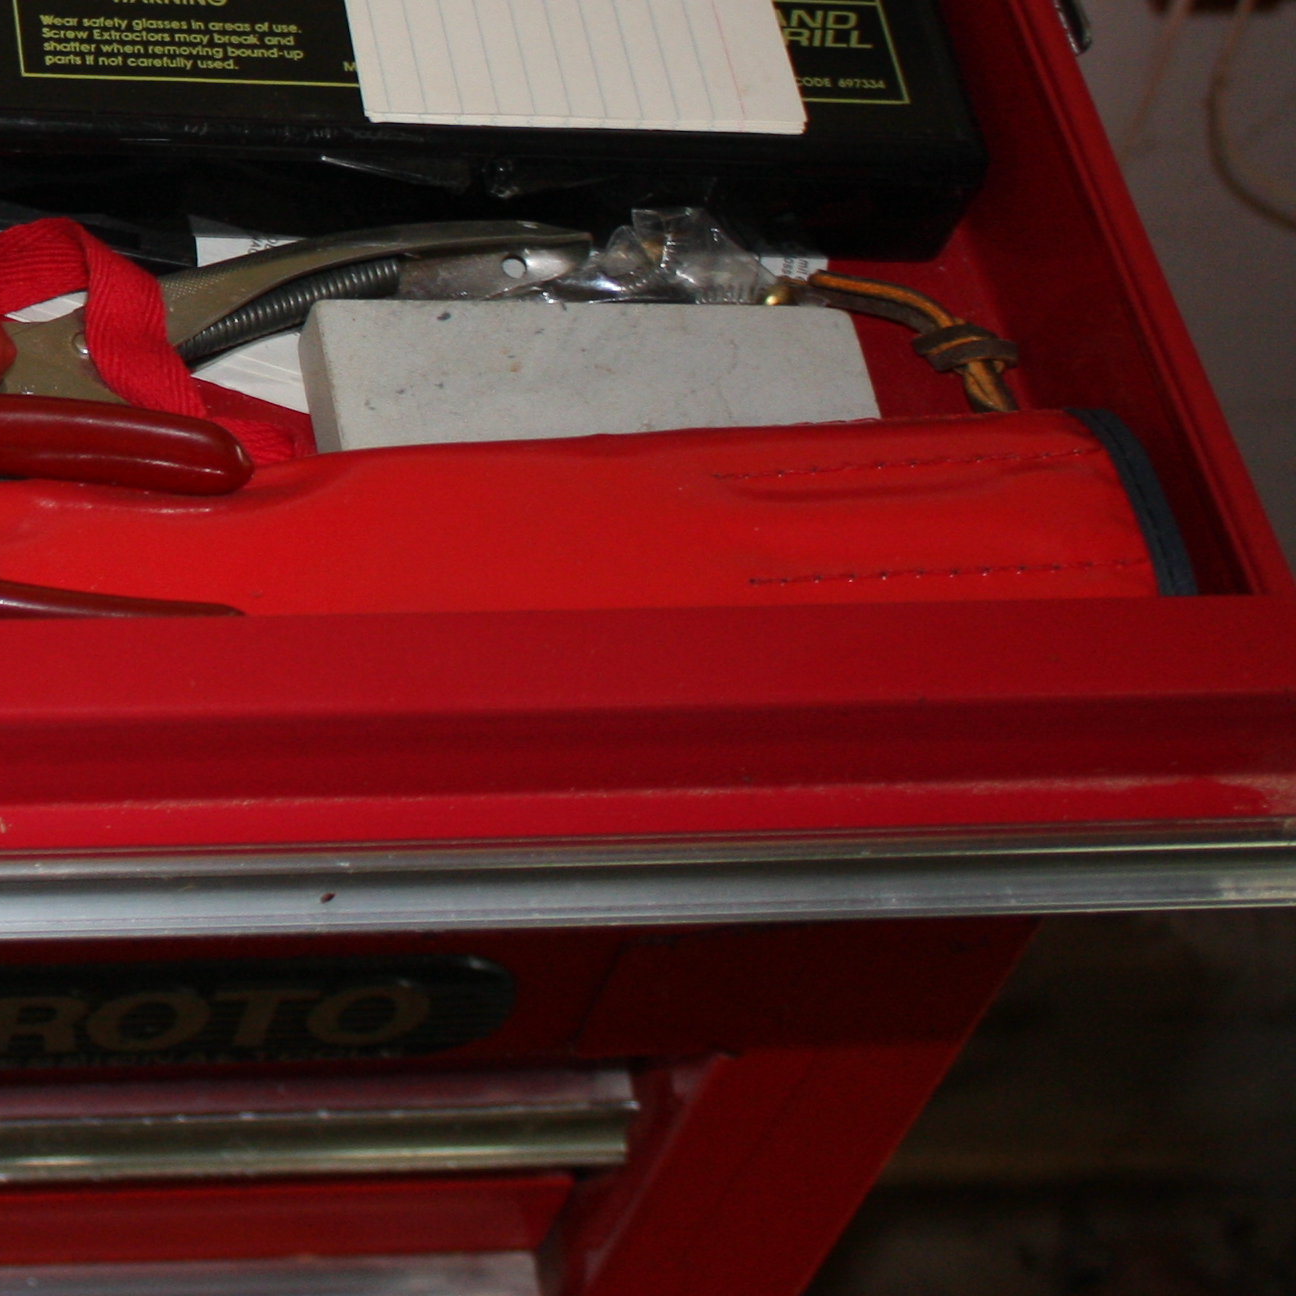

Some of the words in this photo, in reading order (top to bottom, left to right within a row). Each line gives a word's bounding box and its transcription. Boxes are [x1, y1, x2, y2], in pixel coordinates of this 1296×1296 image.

[40, 14, 79, 27] Wear
[83, 16, 128, 31] safety
[133, 18, 185, 32] glasses
[191, 19, 204, 30] in
[208, 22, 251, 32] areas
[255, 20, 270, 33] of
[272, 23, 302, 34] use.
[42, 27, 88, 39] Screw
[94, 29, 169, 42] Extractors
[175, 33, 209, 47] may
[214, 32, 259, 44] break
[264, 34, 295, 45] and
[43, 40, 96, 52] shatter
[101, 43, 143, 55] when
[148, 44, 223, 59] removing
[228, 47, 304, 61] bound-up
[44, 54, 81, 66] parts
[86, 54, 94, 65] if
[99, 55, 123, 66] not
[128, 57, 193, 70] carefully
[197, 59, 239, 70] used.
[838, 78, 886, 90] 697334
